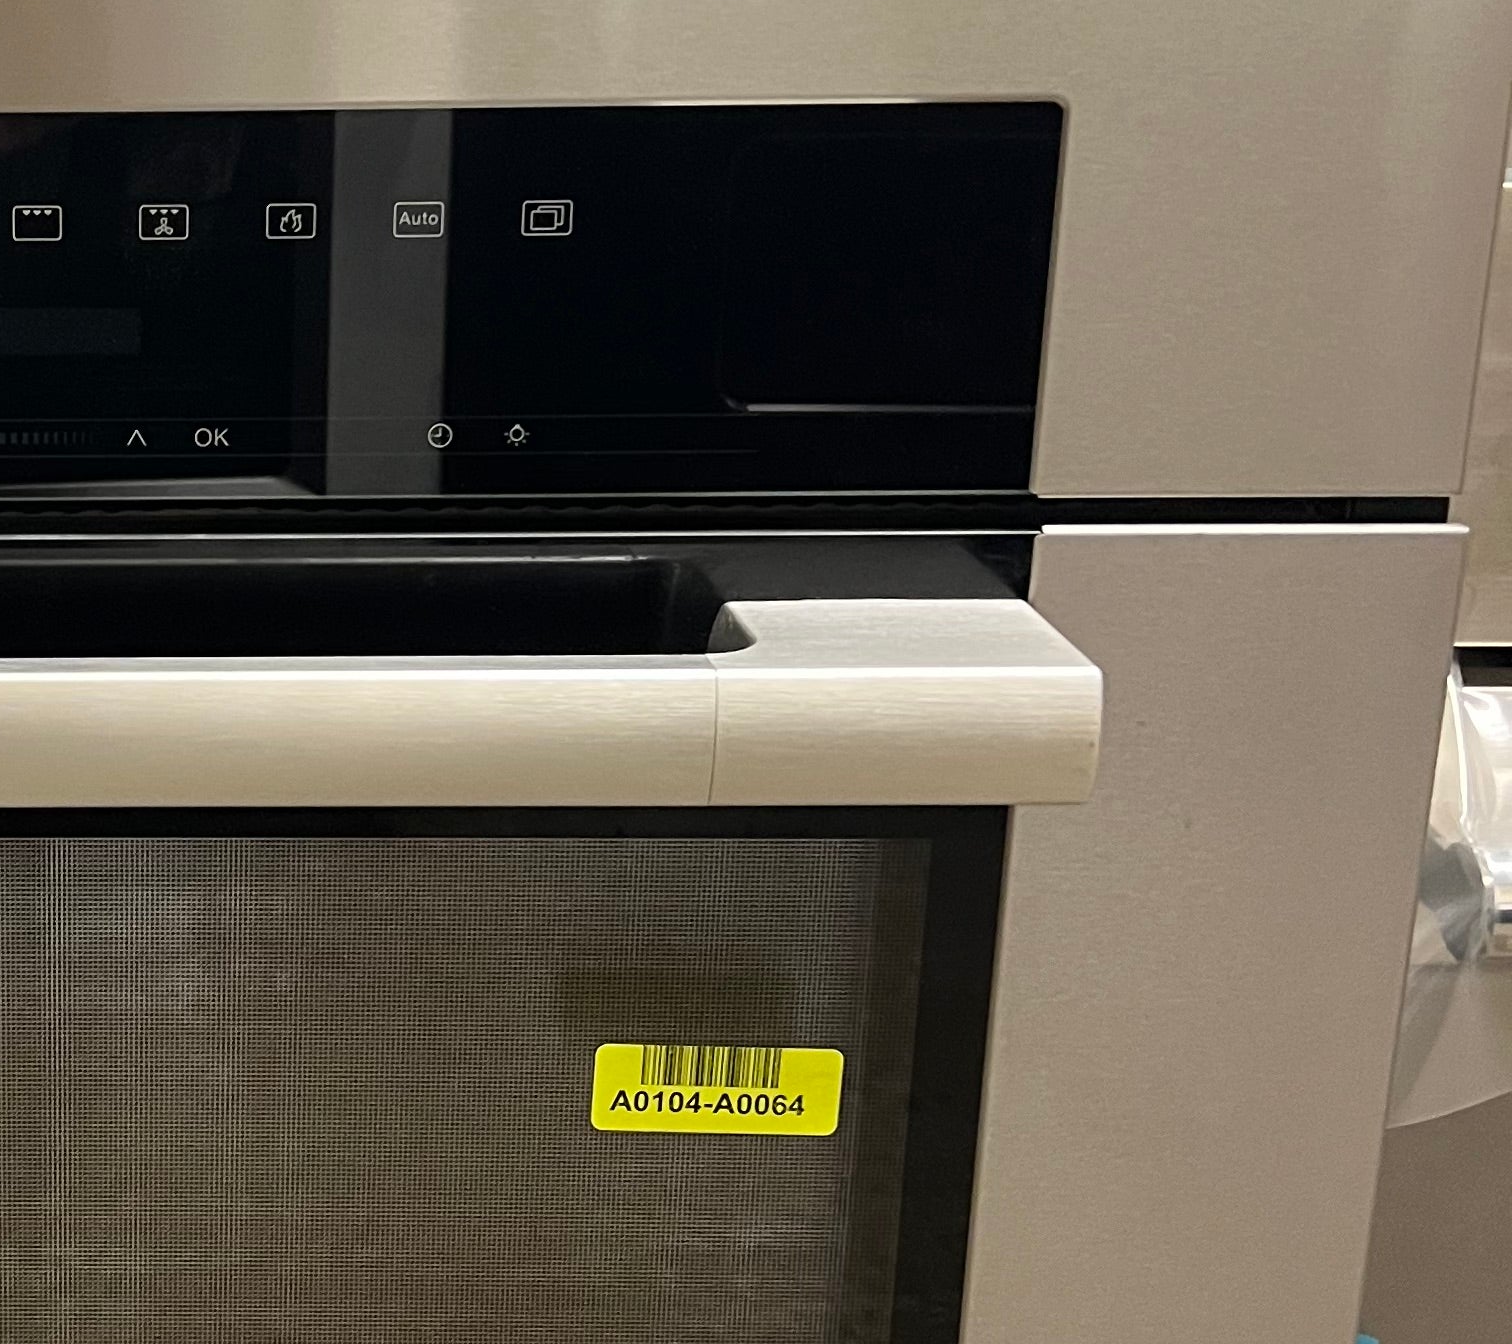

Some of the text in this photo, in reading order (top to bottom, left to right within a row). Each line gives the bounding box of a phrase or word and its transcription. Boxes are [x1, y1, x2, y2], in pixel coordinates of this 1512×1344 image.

[399, 211, 438, 226] Auto
[194, 427, 229, 447] OK
[610, 1089, 805, 1116] A0104-A0064
